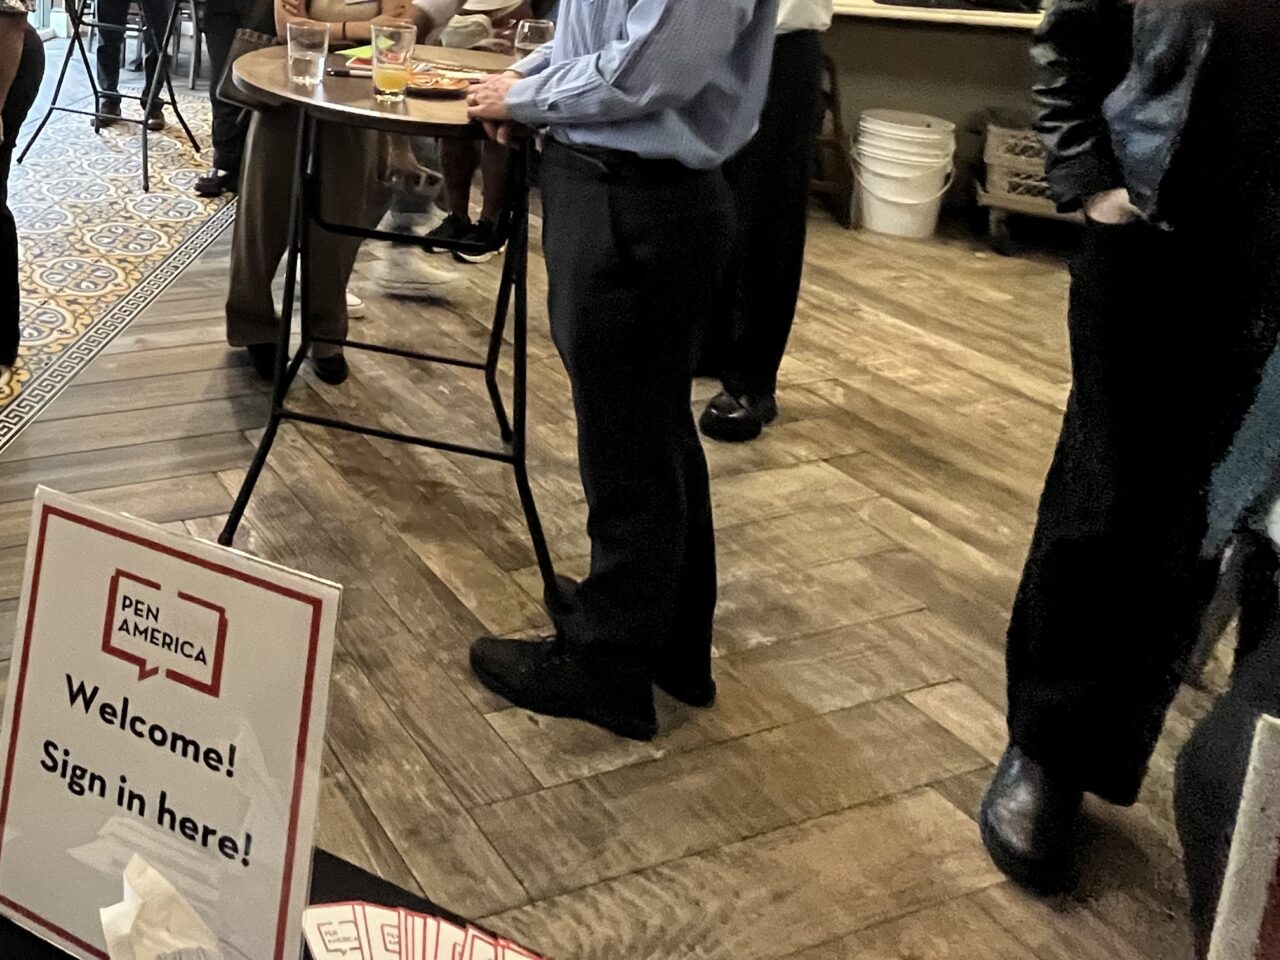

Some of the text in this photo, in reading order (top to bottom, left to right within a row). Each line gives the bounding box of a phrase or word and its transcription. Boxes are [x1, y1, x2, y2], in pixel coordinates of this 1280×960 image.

[118, 618, 207, 666] AMERICA
[121, 594, 160, 623] PEN
[66, 673, 237, 778] Welcome!
[40, 739, 253, 868] Sign in here!
